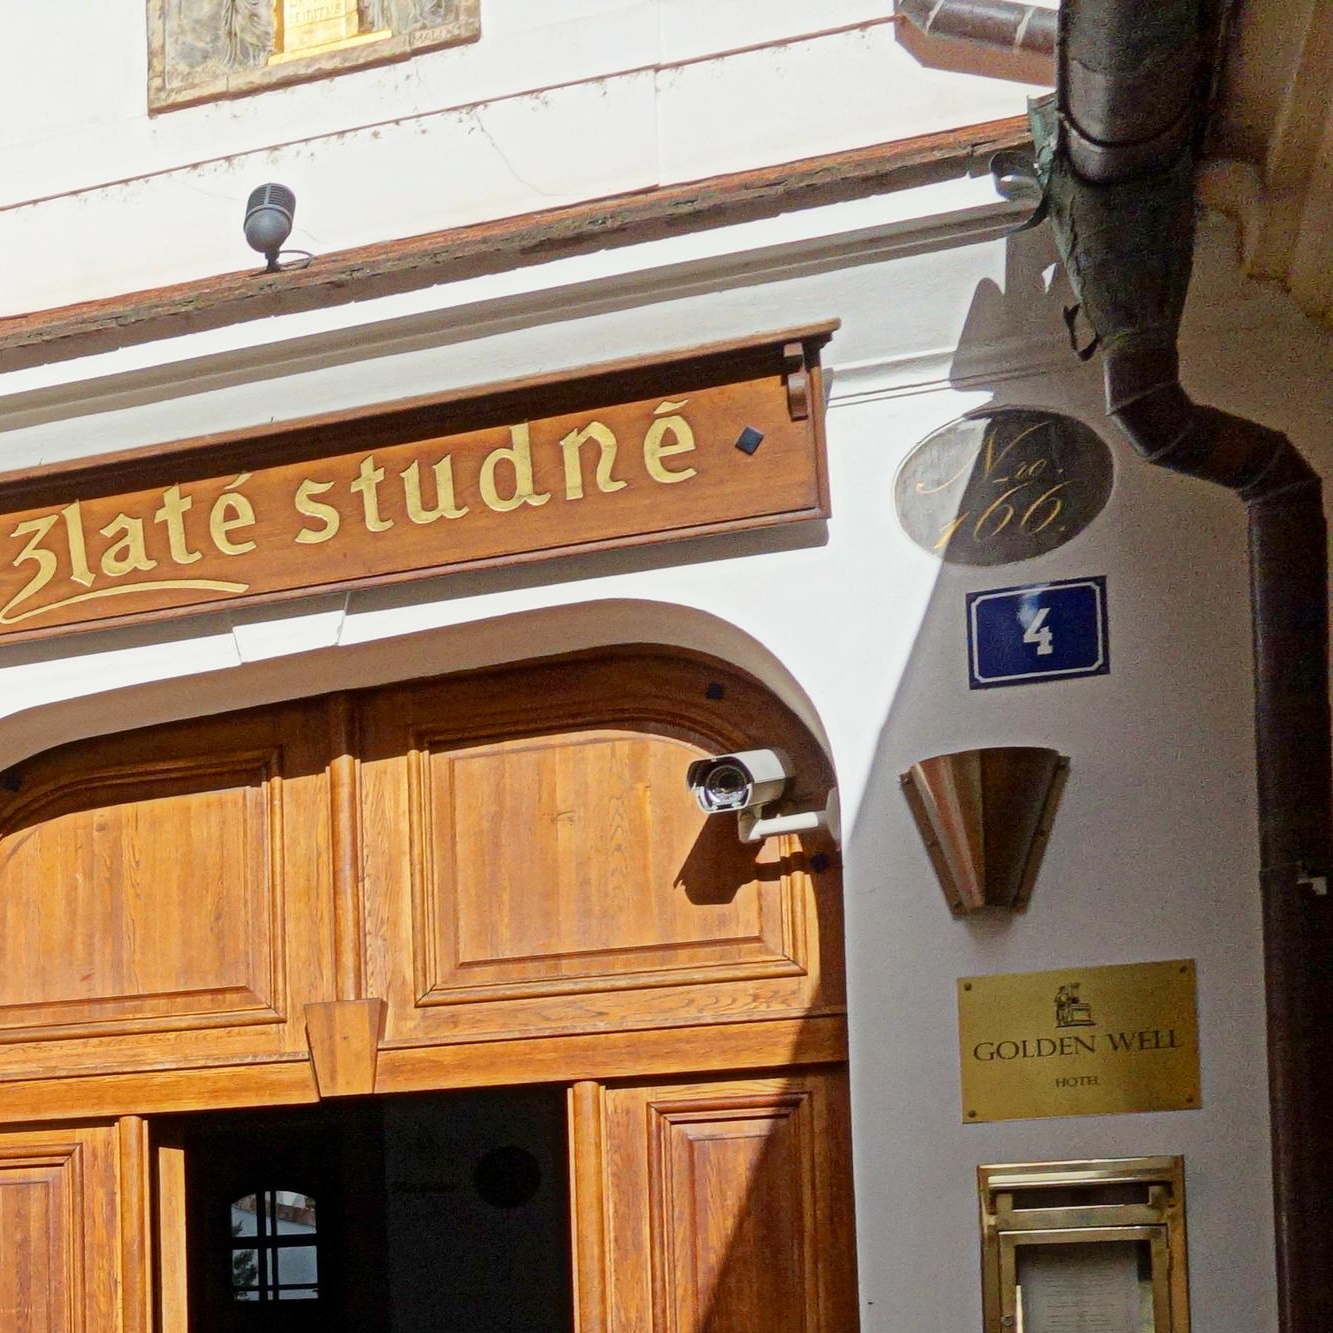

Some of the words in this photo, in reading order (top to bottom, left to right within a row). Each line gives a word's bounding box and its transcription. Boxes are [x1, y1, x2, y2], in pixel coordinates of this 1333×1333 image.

[1023, 607, 1054, 656] 4
[973, 1034, 1096, 1062] GOLDEN
[1107, 1028, 1184, 1052] WELL
[1055, 1075, 1102, 1089] HOTEL
